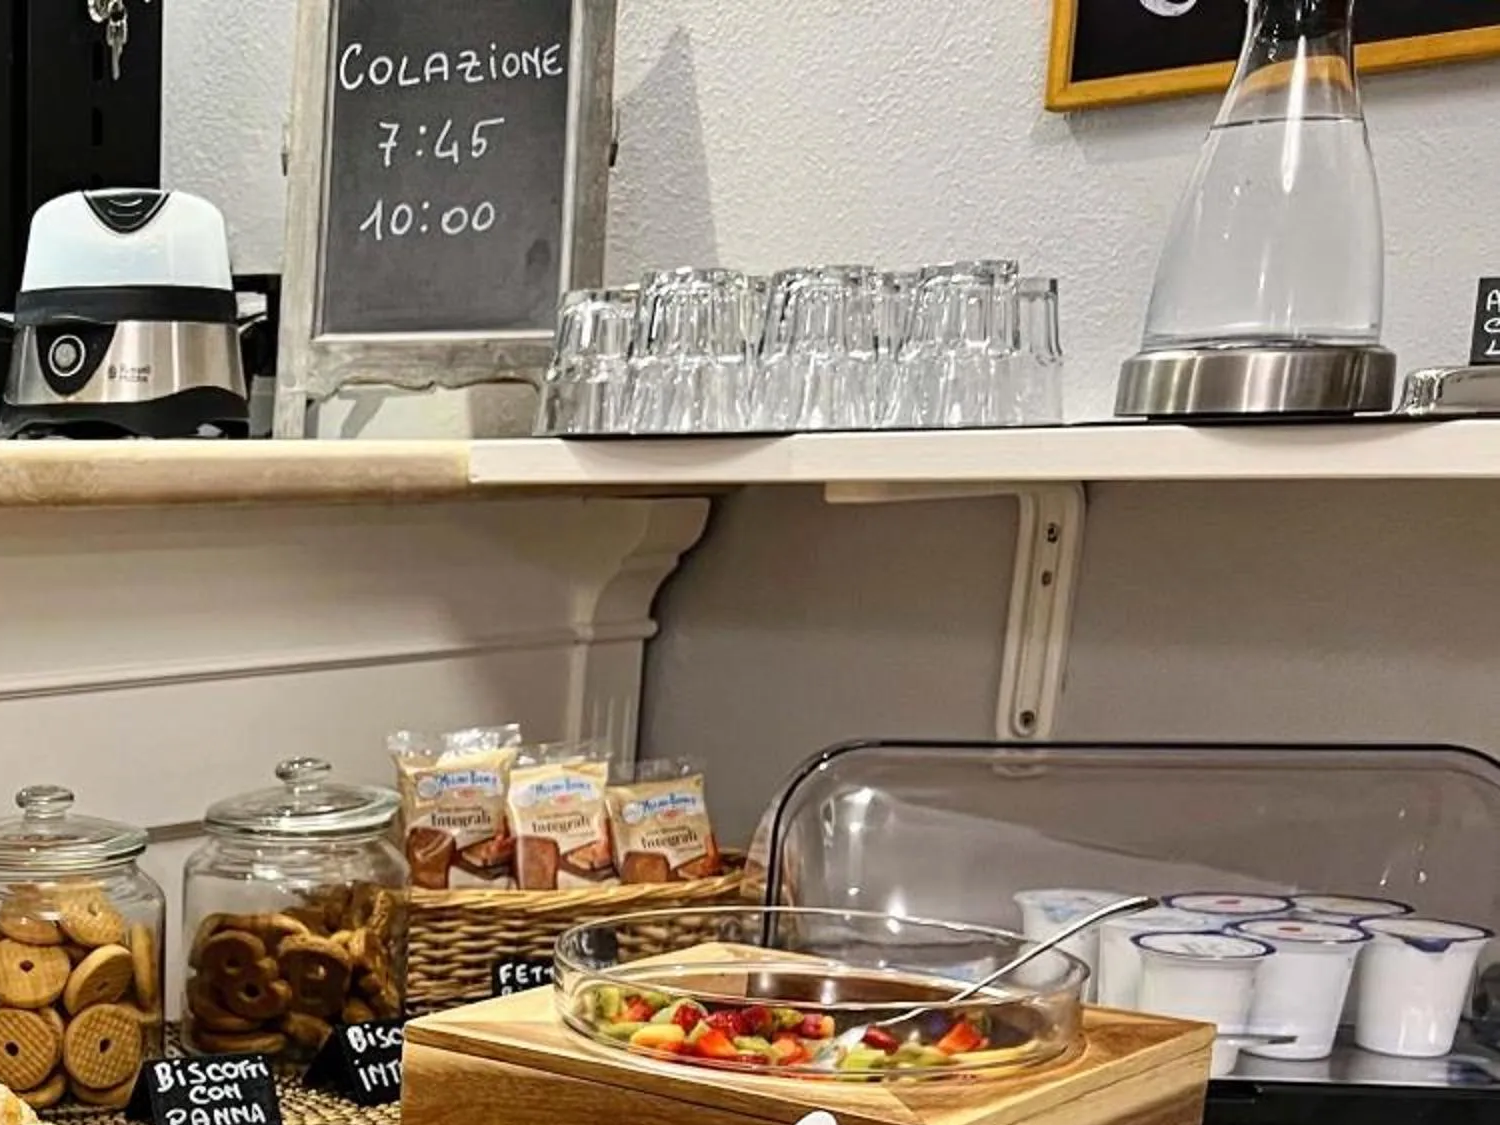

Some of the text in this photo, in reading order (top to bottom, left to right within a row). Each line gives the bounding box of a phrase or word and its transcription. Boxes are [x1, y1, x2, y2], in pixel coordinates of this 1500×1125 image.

[378, 117, 505, 167] 7:45
[360, 200, 495, 241] 10:00
[499, 961, 555, 985] FETT
[188, 1082, 243, 1104] CON
